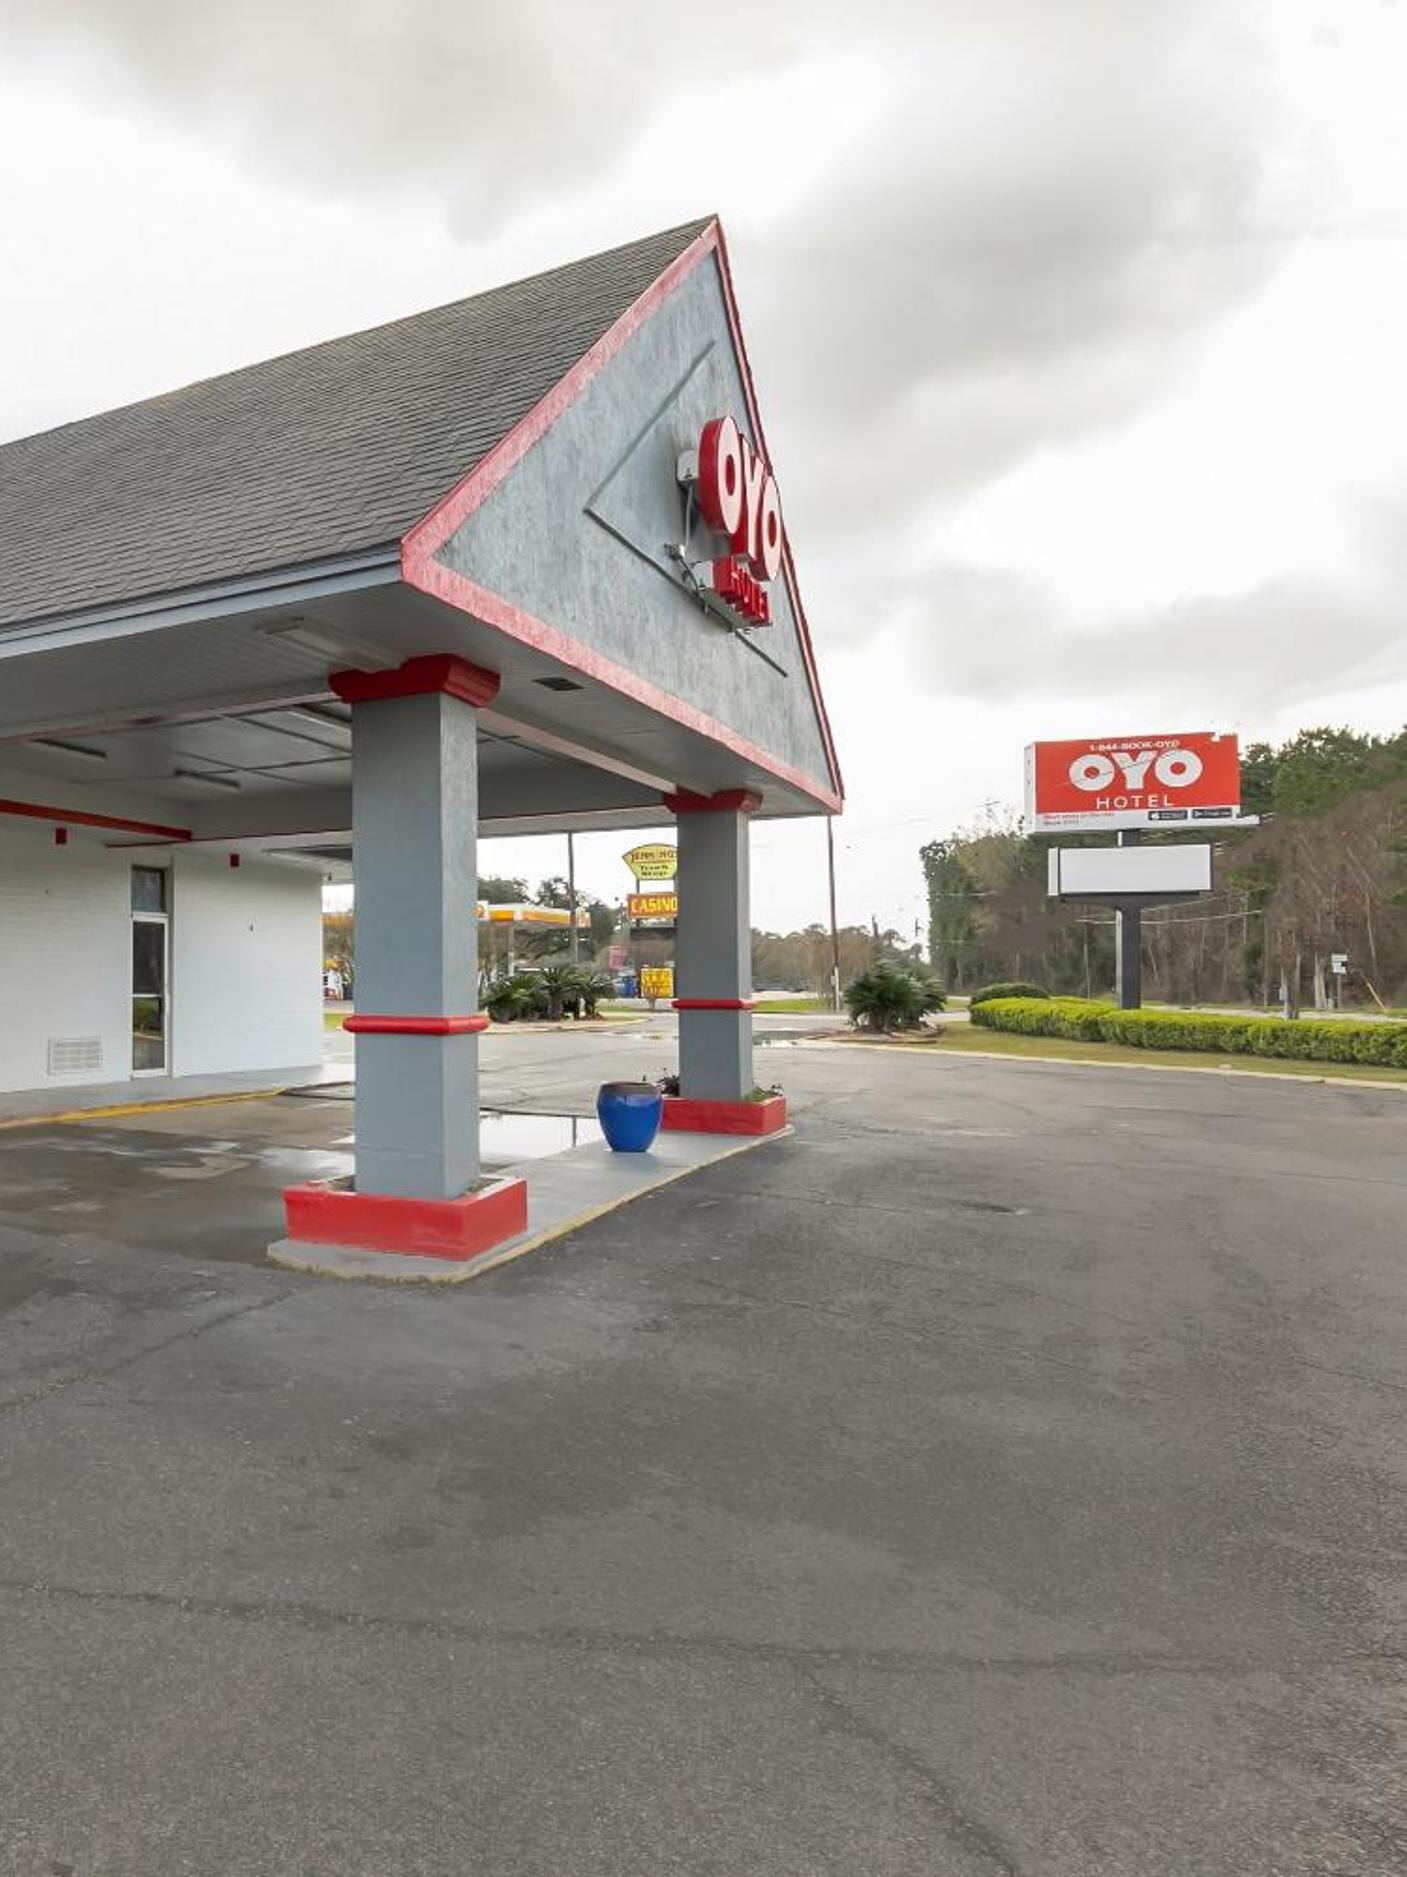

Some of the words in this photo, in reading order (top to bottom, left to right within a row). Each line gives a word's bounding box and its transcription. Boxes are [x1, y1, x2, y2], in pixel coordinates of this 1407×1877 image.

[716, 415, 782, 582] OYO
[1068, 749, 1204, 791] OYO
[1095, 794, 1175, 810] HOTEL
[630, 897, 678, 914] CASINO
